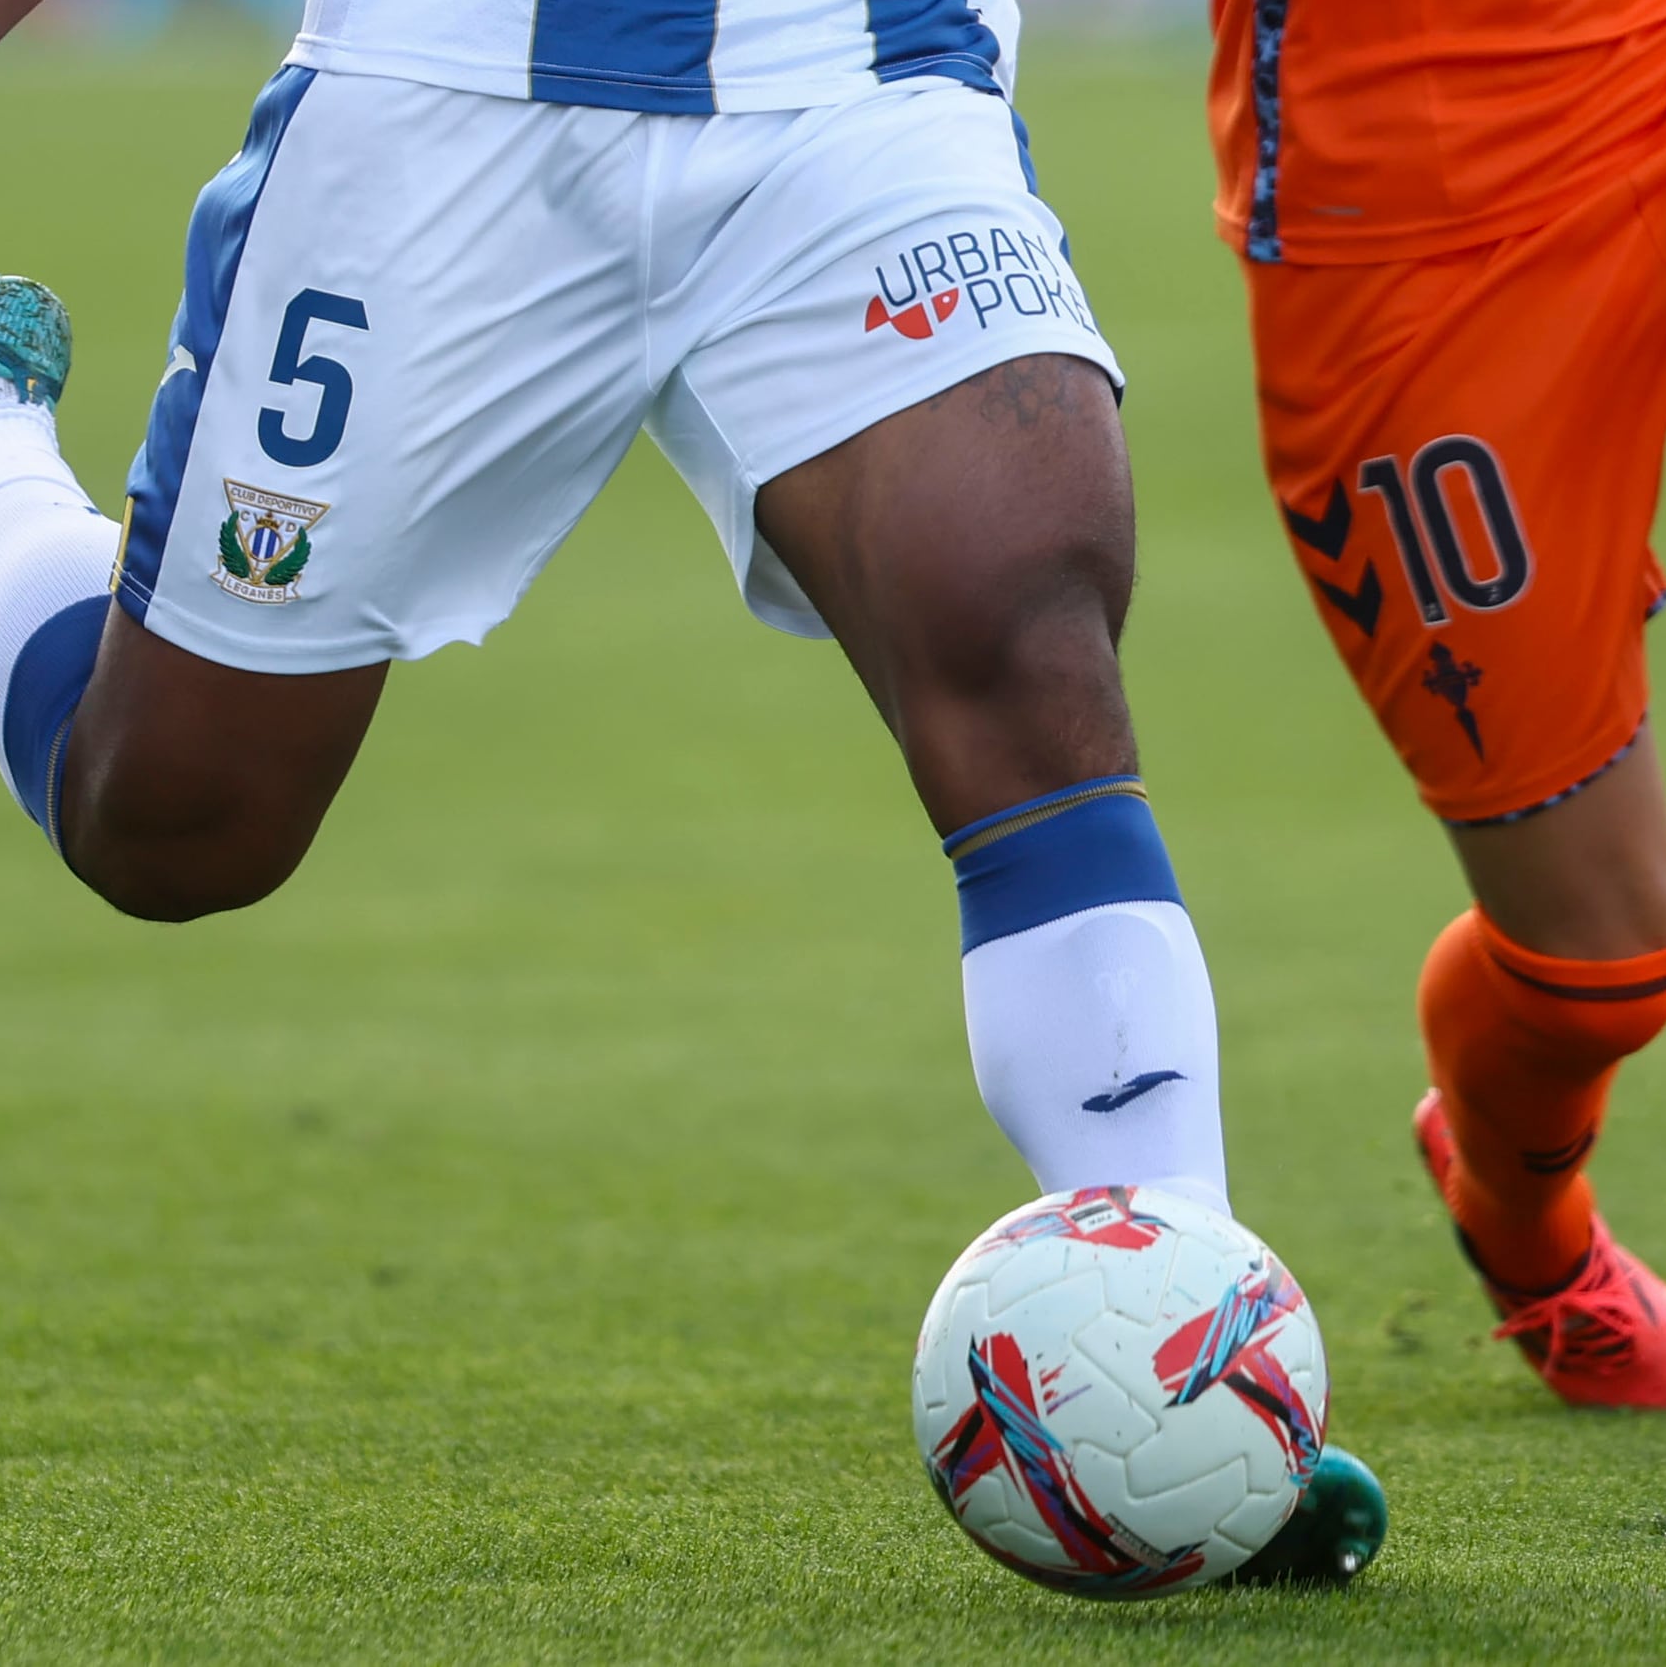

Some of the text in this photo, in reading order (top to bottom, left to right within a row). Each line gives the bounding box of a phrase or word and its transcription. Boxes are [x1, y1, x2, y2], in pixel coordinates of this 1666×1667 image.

[875, 227, 1061, 307] URBAN
[965, 272, 1097, 336] POKE
[257, 286, 370, 469] 5
[230, 486, 318, 516] CLUB DEPORTIVO
[240, 510, 297, 533] C D
[1357, 433, 1535, 626] 10
